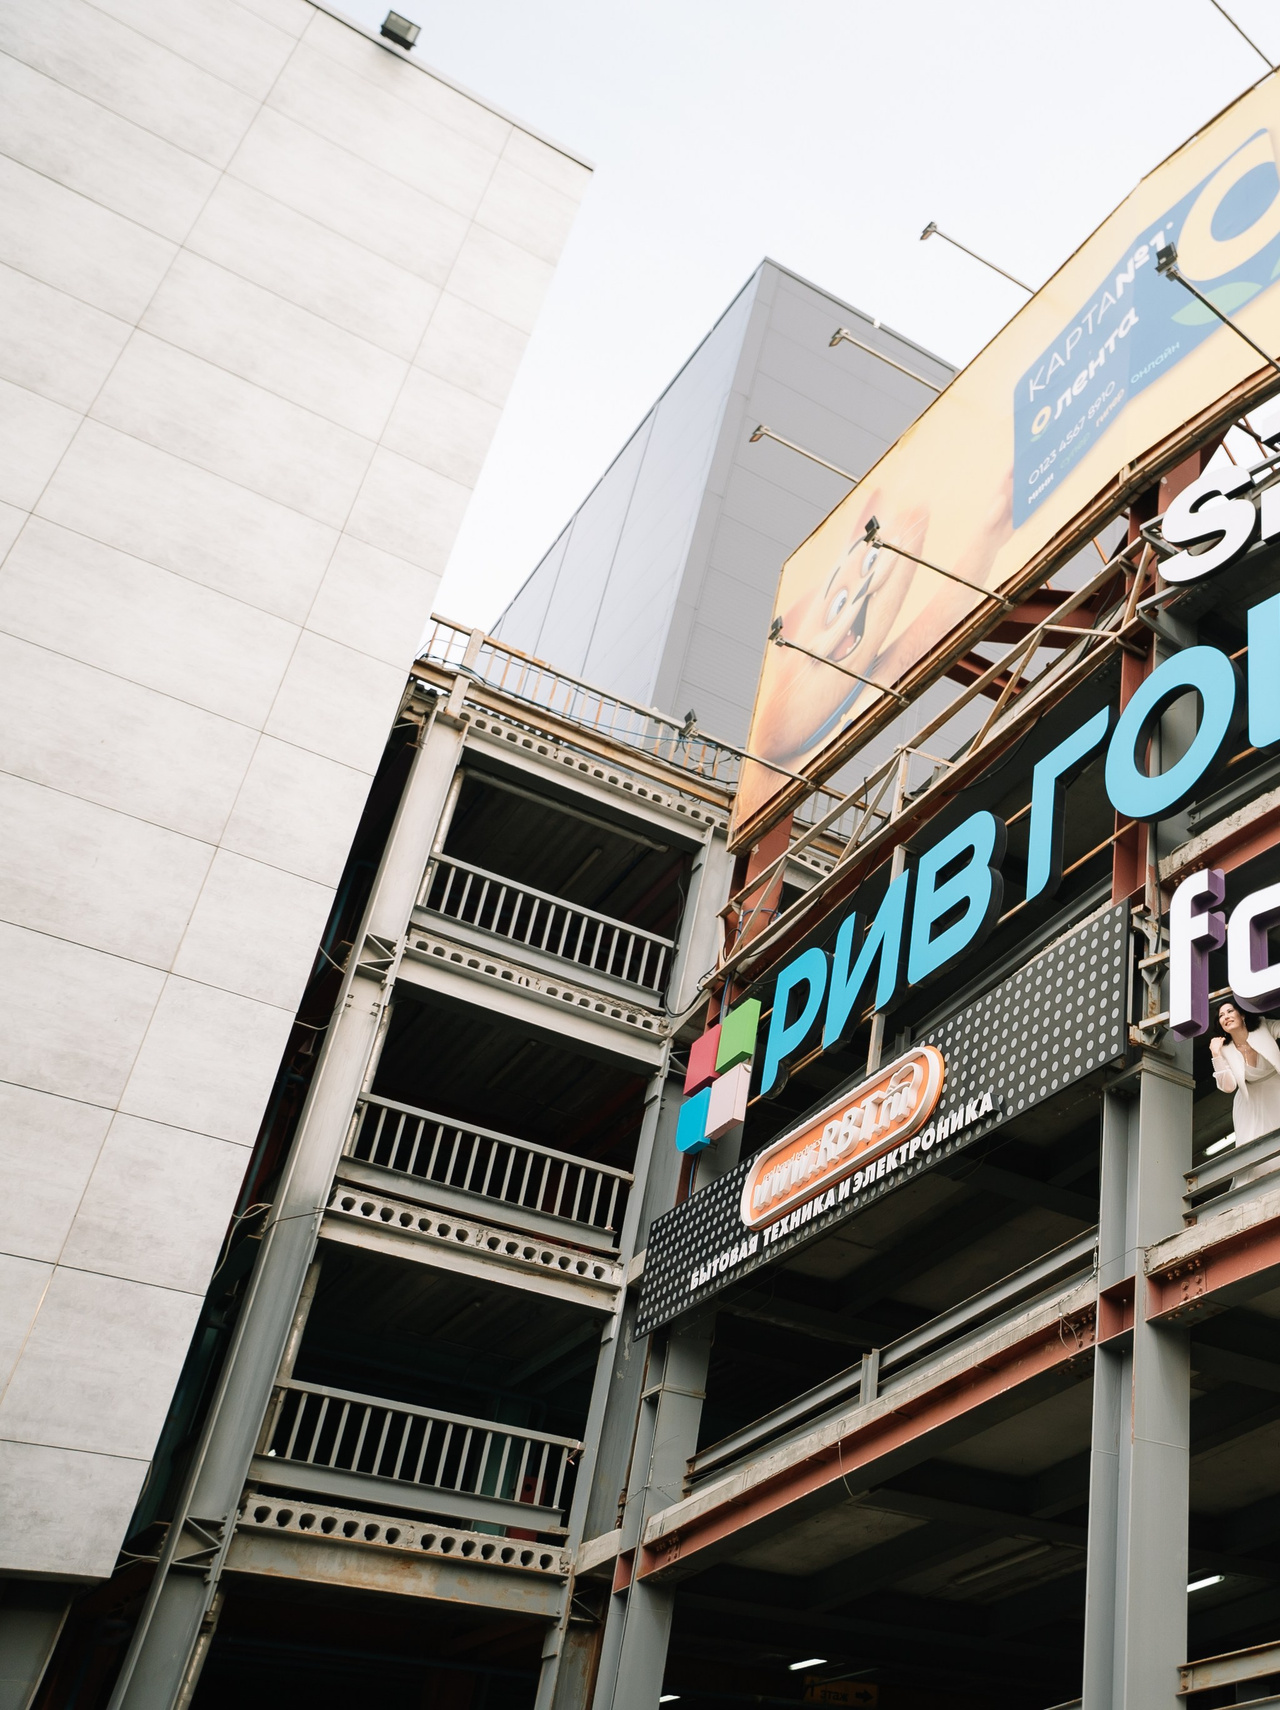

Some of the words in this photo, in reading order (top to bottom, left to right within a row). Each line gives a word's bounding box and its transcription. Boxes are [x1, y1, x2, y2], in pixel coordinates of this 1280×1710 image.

[1028, 449, 1058, 485] 0123
[1058, 415, 1086, 453] 4567
[1087, 380, 1116, 420] 8910
[1130, 341, 1181, 384] онлайн
[760, 809, 1004, 1098] РИВ
[689, 1234, 759, 1292] БЫТОВАЯ
[762, 1188, 837, 1248] ТЕХНИКА
[838, 1177, 852, 1203] И
[852, 1092, 994, 1194] ЭЛЕКТРОНИКА
